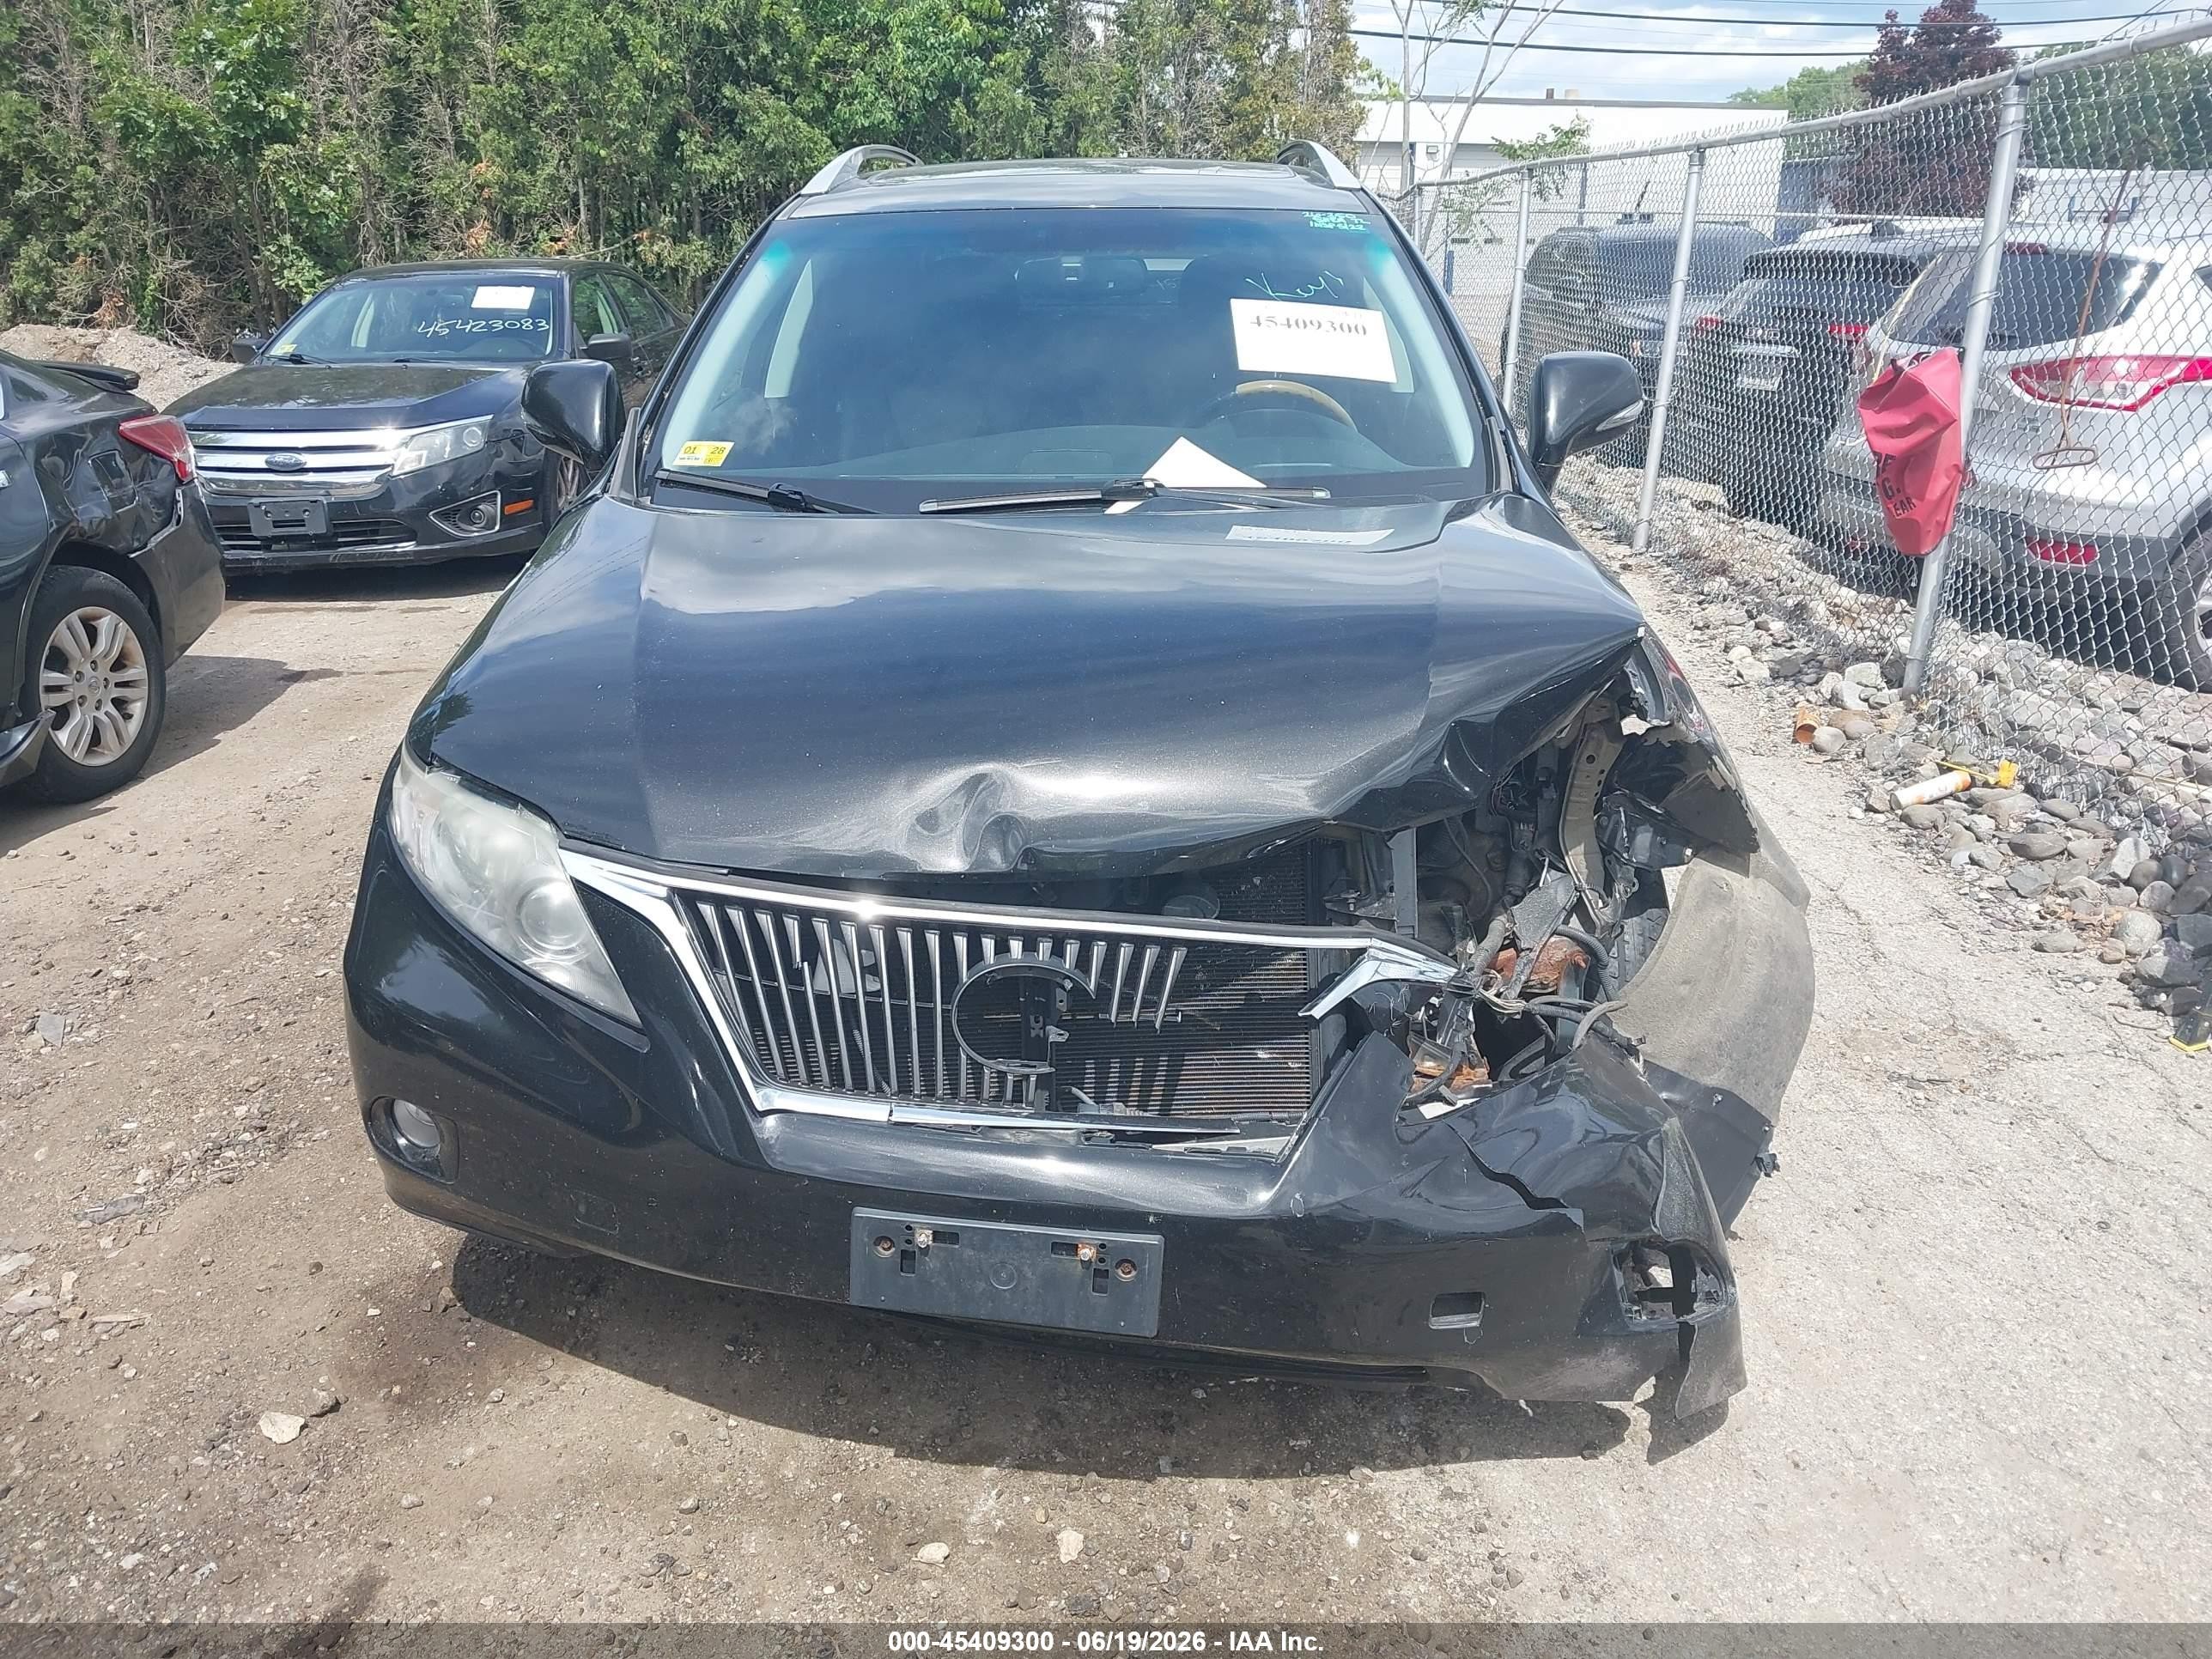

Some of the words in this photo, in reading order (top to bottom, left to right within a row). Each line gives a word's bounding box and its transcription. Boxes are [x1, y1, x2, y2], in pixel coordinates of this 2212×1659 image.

[417, 318, 550, 338] 45423083
[1249, 314, 1368, 337] 45409300
[684, 446, 697, 454] 01
[710, 446, 726, 455] 28
